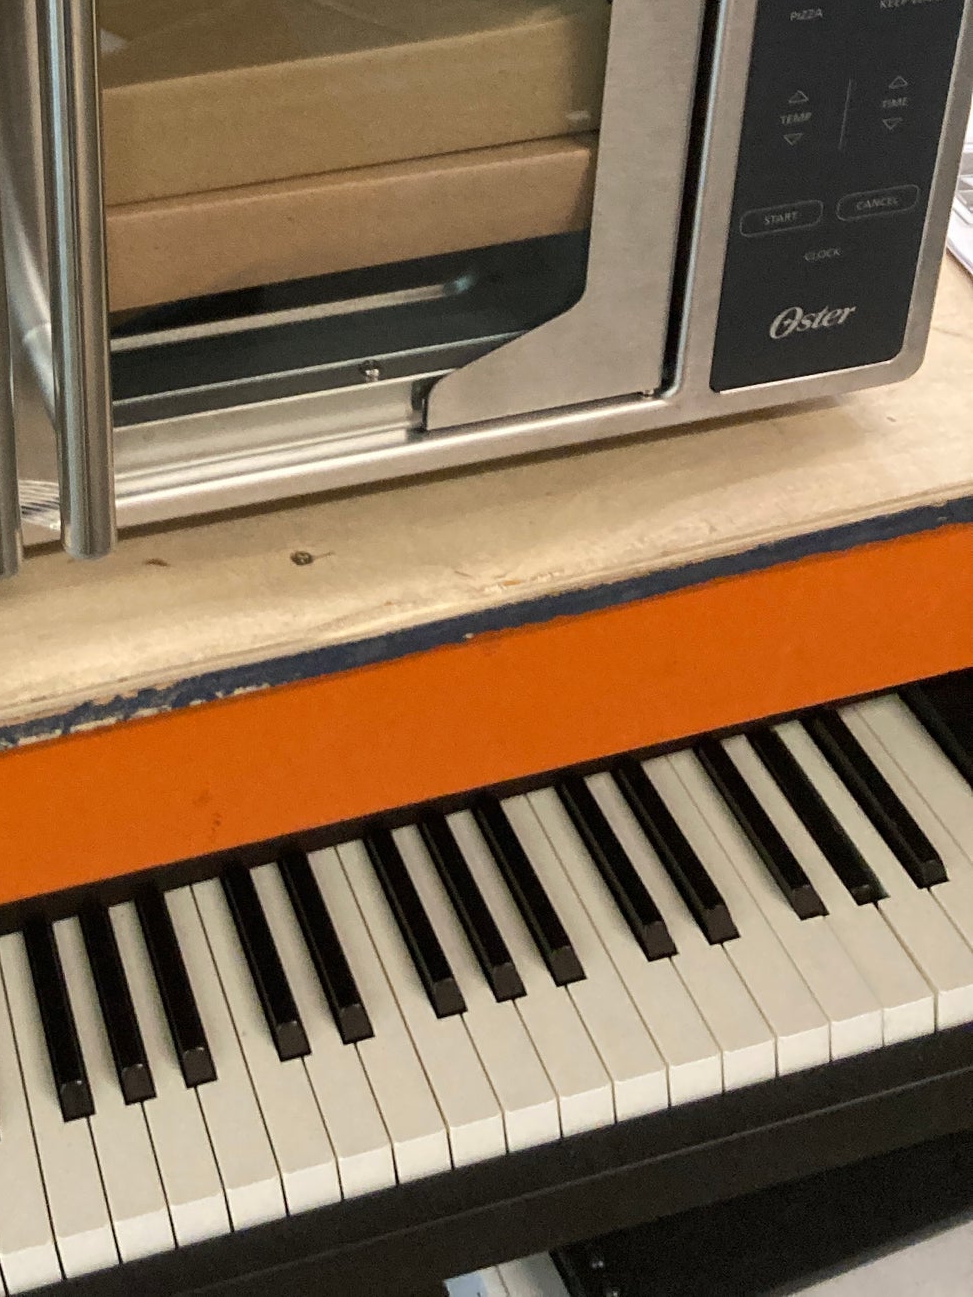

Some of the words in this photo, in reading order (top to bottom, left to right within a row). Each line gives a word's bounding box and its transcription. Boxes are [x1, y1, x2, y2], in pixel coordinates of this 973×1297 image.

[790, 8, 823, 21] PIZZA
[882, 96, 908, 108] TIME
[780, 112, 813, 125] TEMP
[856, 196, 899, 211] CANCEL
[764, 210, 799, 226] START
[804, 247, 842, 262] CLOCK
[769, 305, 857, 340] Oster
